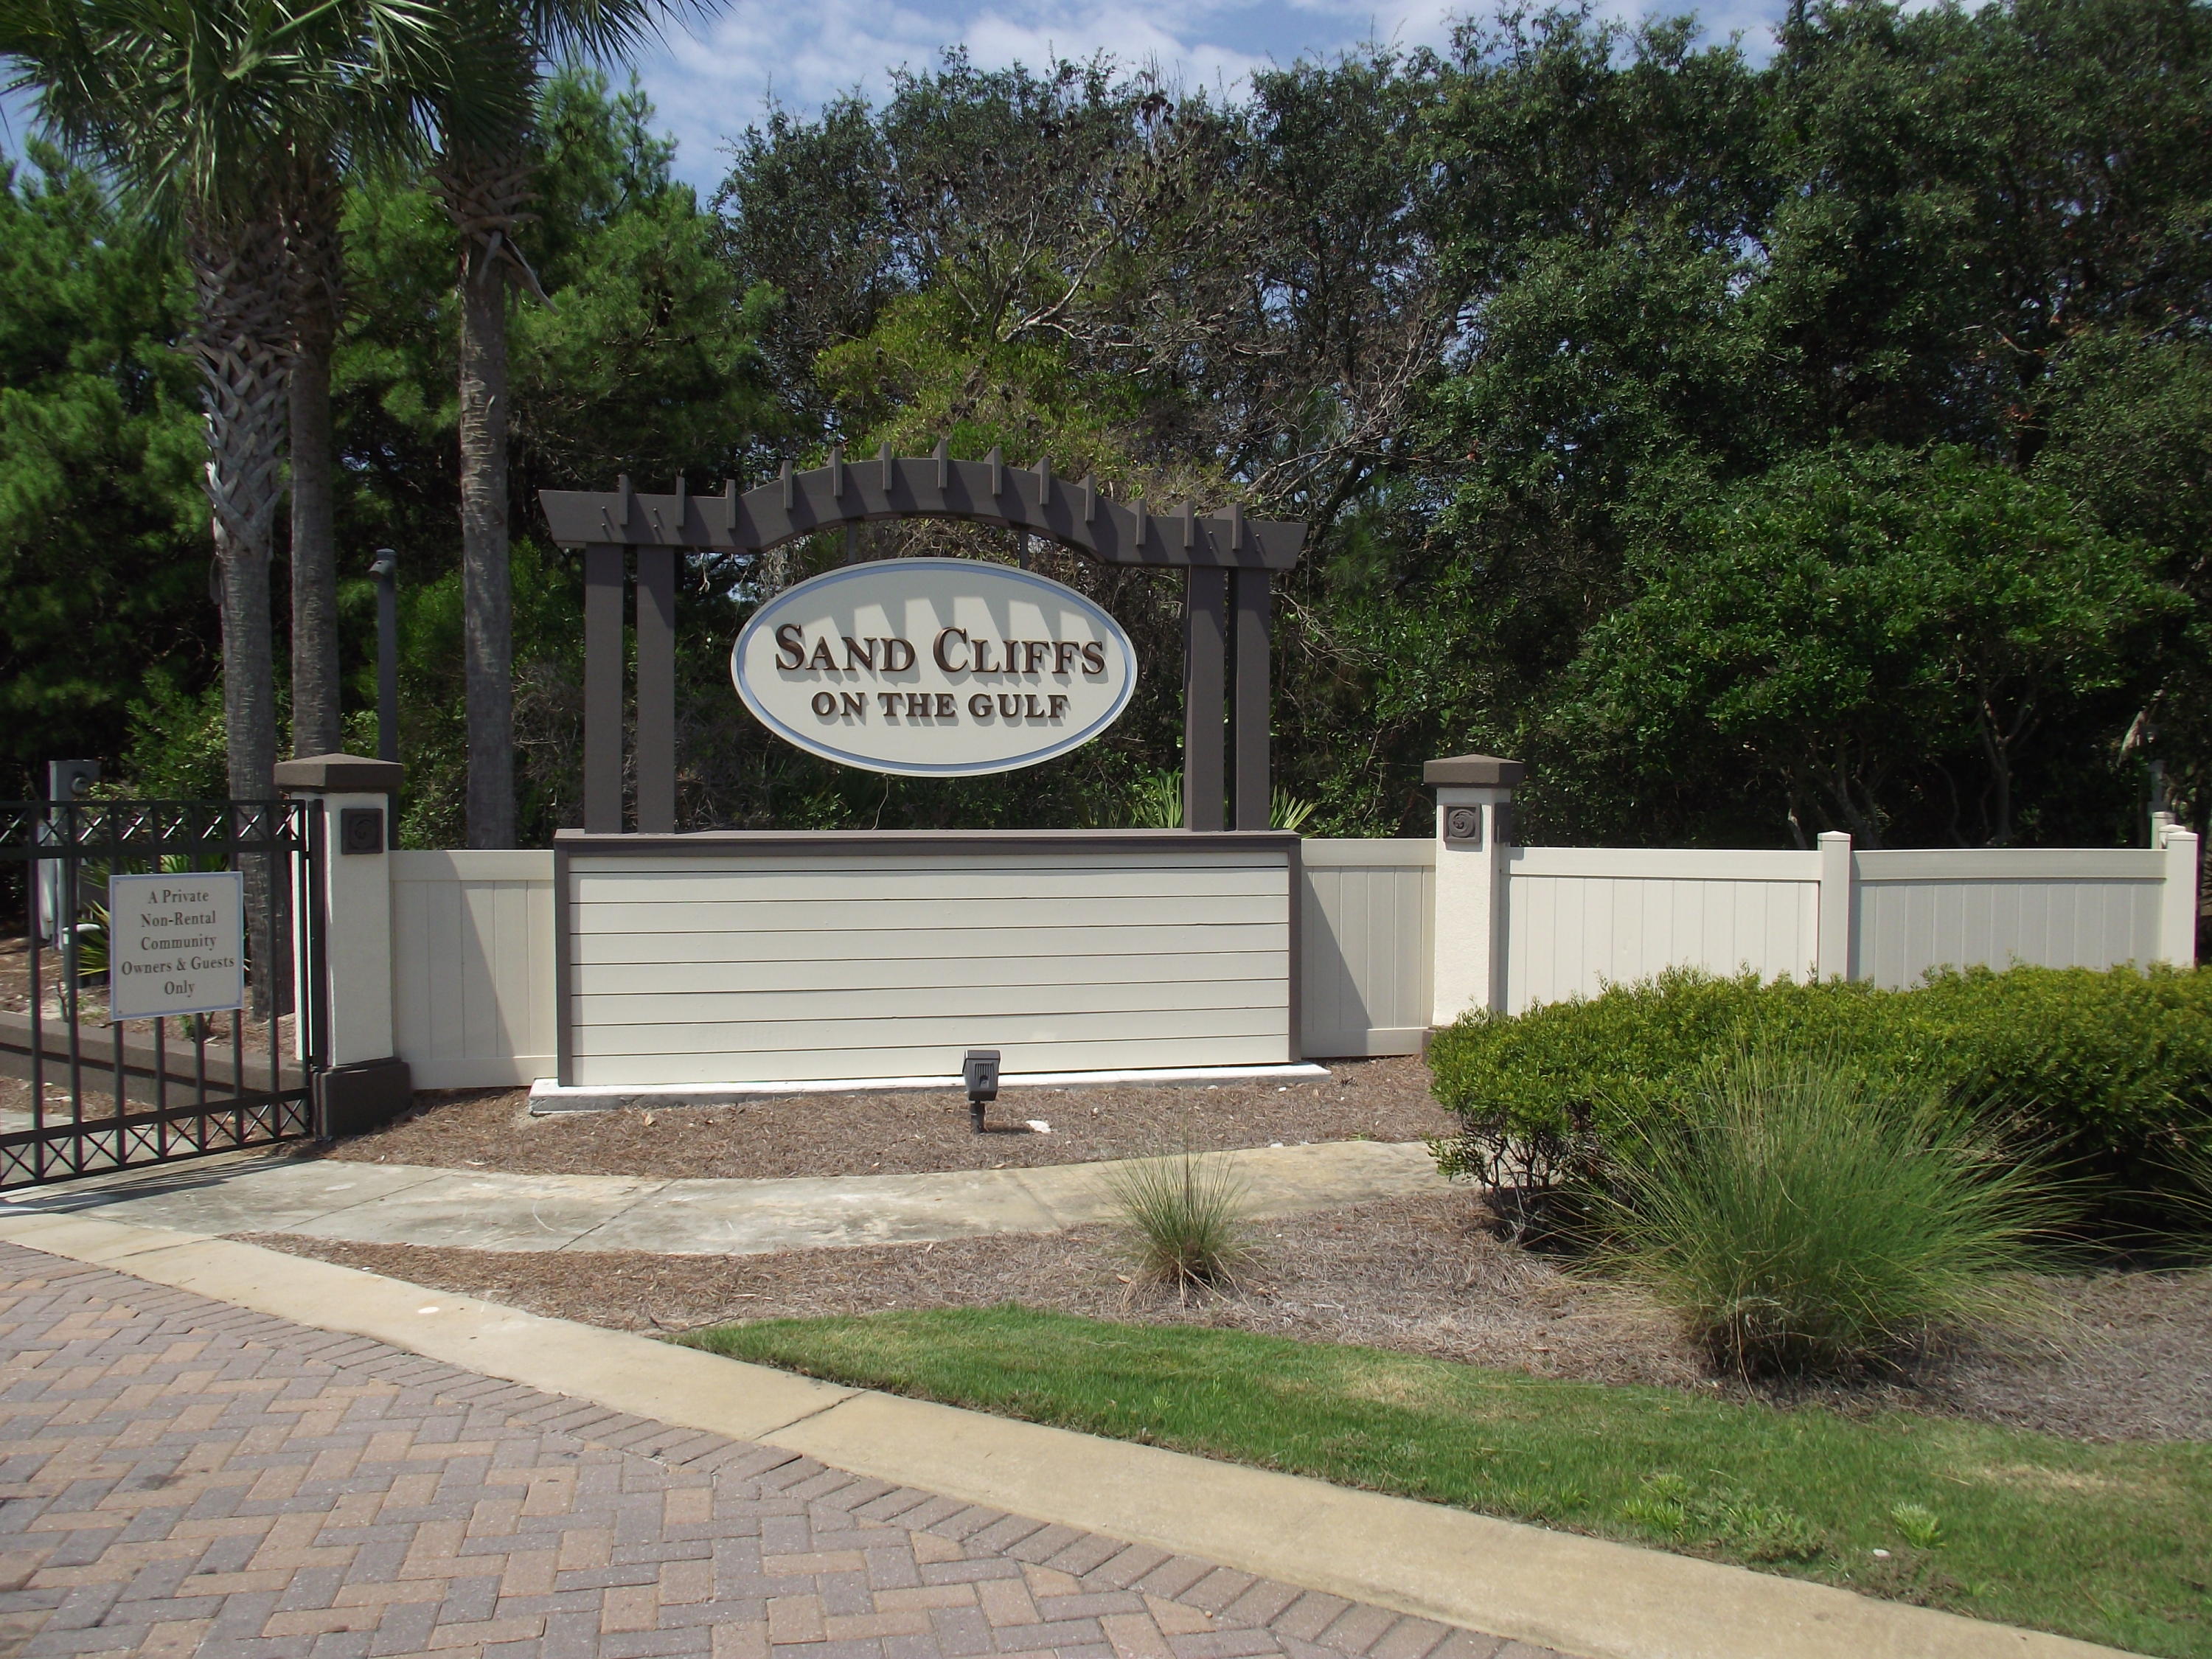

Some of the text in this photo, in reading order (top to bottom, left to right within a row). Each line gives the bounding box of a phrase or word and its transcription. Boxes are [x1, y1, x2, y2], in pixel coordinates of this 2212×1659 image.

[774, 623, 1105, 675] SAND CLIFFS
[811, 691, 1068, 720] ON THE GULF
[148, 889, 209, 904] A Private
[141, 910, 216, 928] Non-Rental
[141, 933, 217, 951] Community
[122, 956, 235, 975] Owners & Guests
[164, 980, 195, 998] Only
